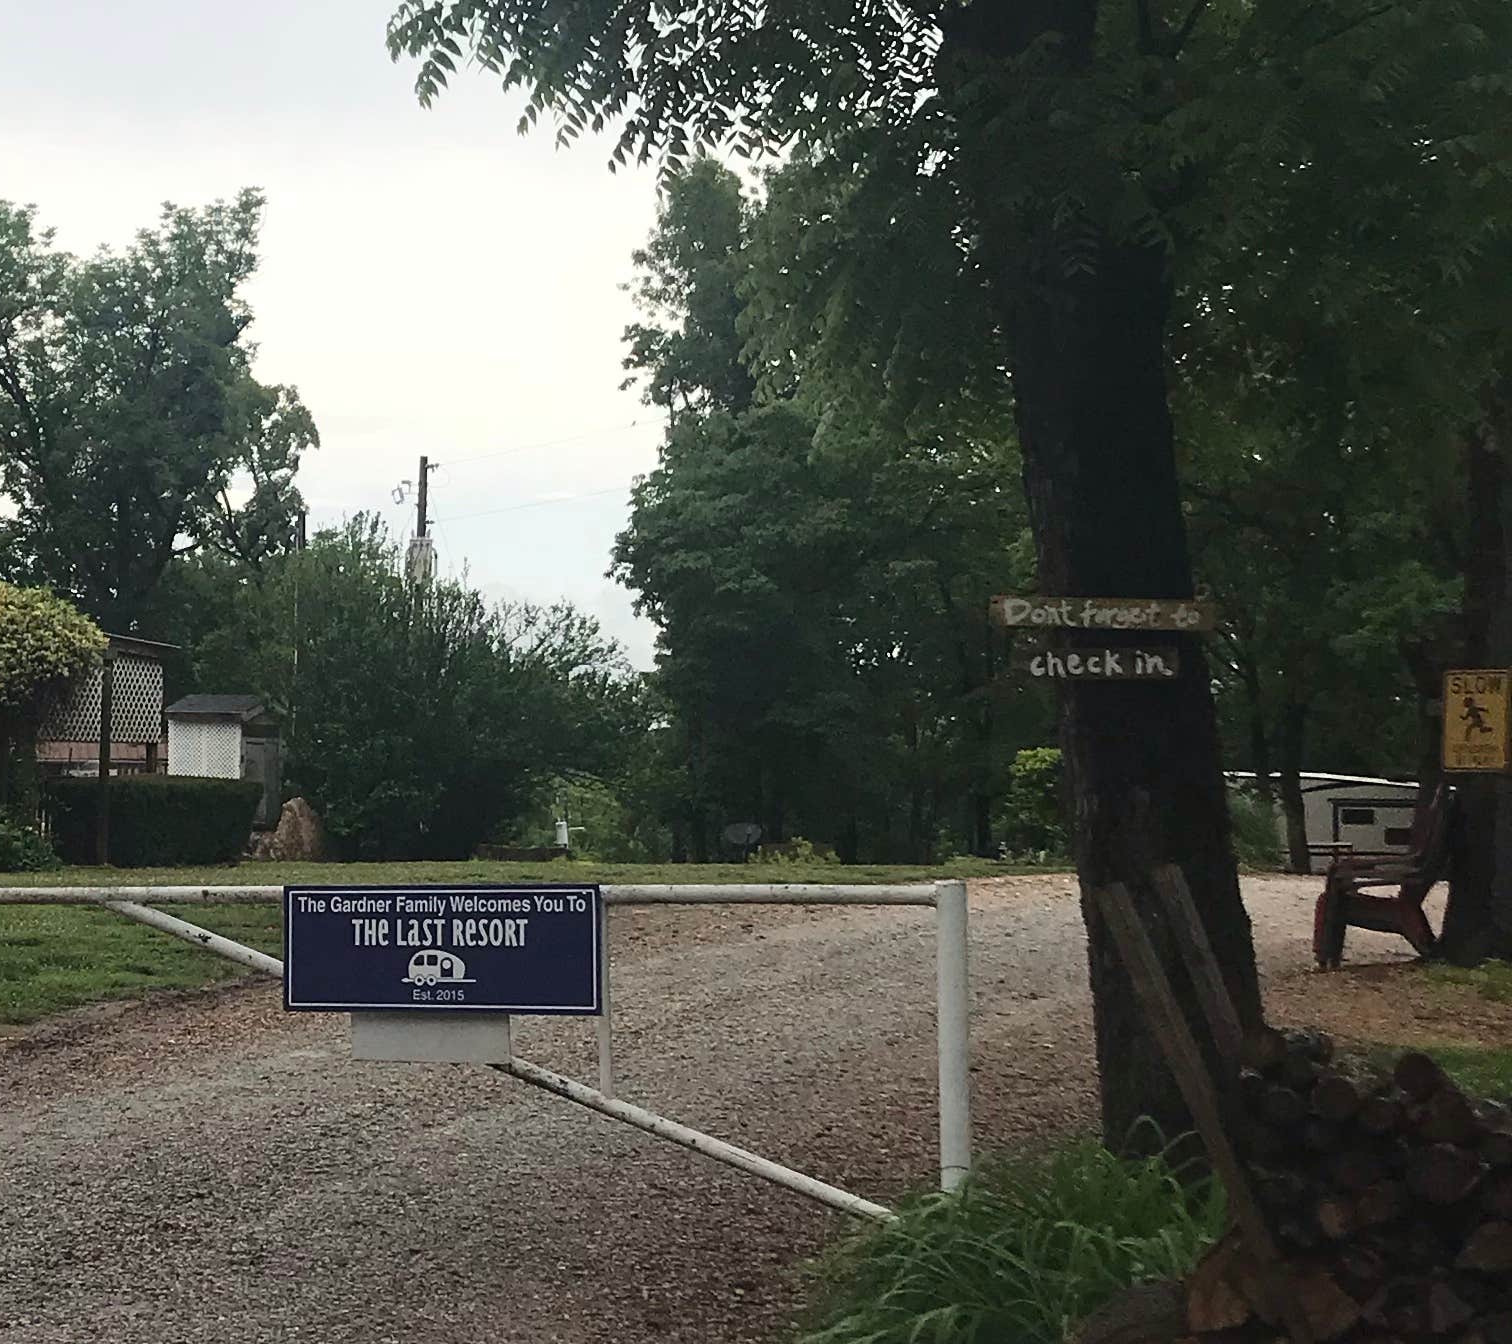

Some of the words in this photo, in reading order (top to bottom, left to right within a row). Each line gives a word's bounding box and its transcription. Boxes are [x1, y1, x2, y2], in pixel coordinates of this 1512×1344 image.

[1080, 599, 1160, 629] forget
[1171, 603, 1201, 627] to
[1030, 650, 1123, 678] check
[1136, 650, 1174, 676] in
[1451, 676, 1501, 695] SLOW
[297, 896, 325, 913] The
[330, 896, 392, 913] Gardner
[396, 896, 445, 916] Family
[449, 896, 530, 913] Welcomes
[534, 896, 563, 913] You
[567, 895, 586, 913] To
[412, 989, 434, 1001] Est.
[436, 989, 464, 1001] 2015
